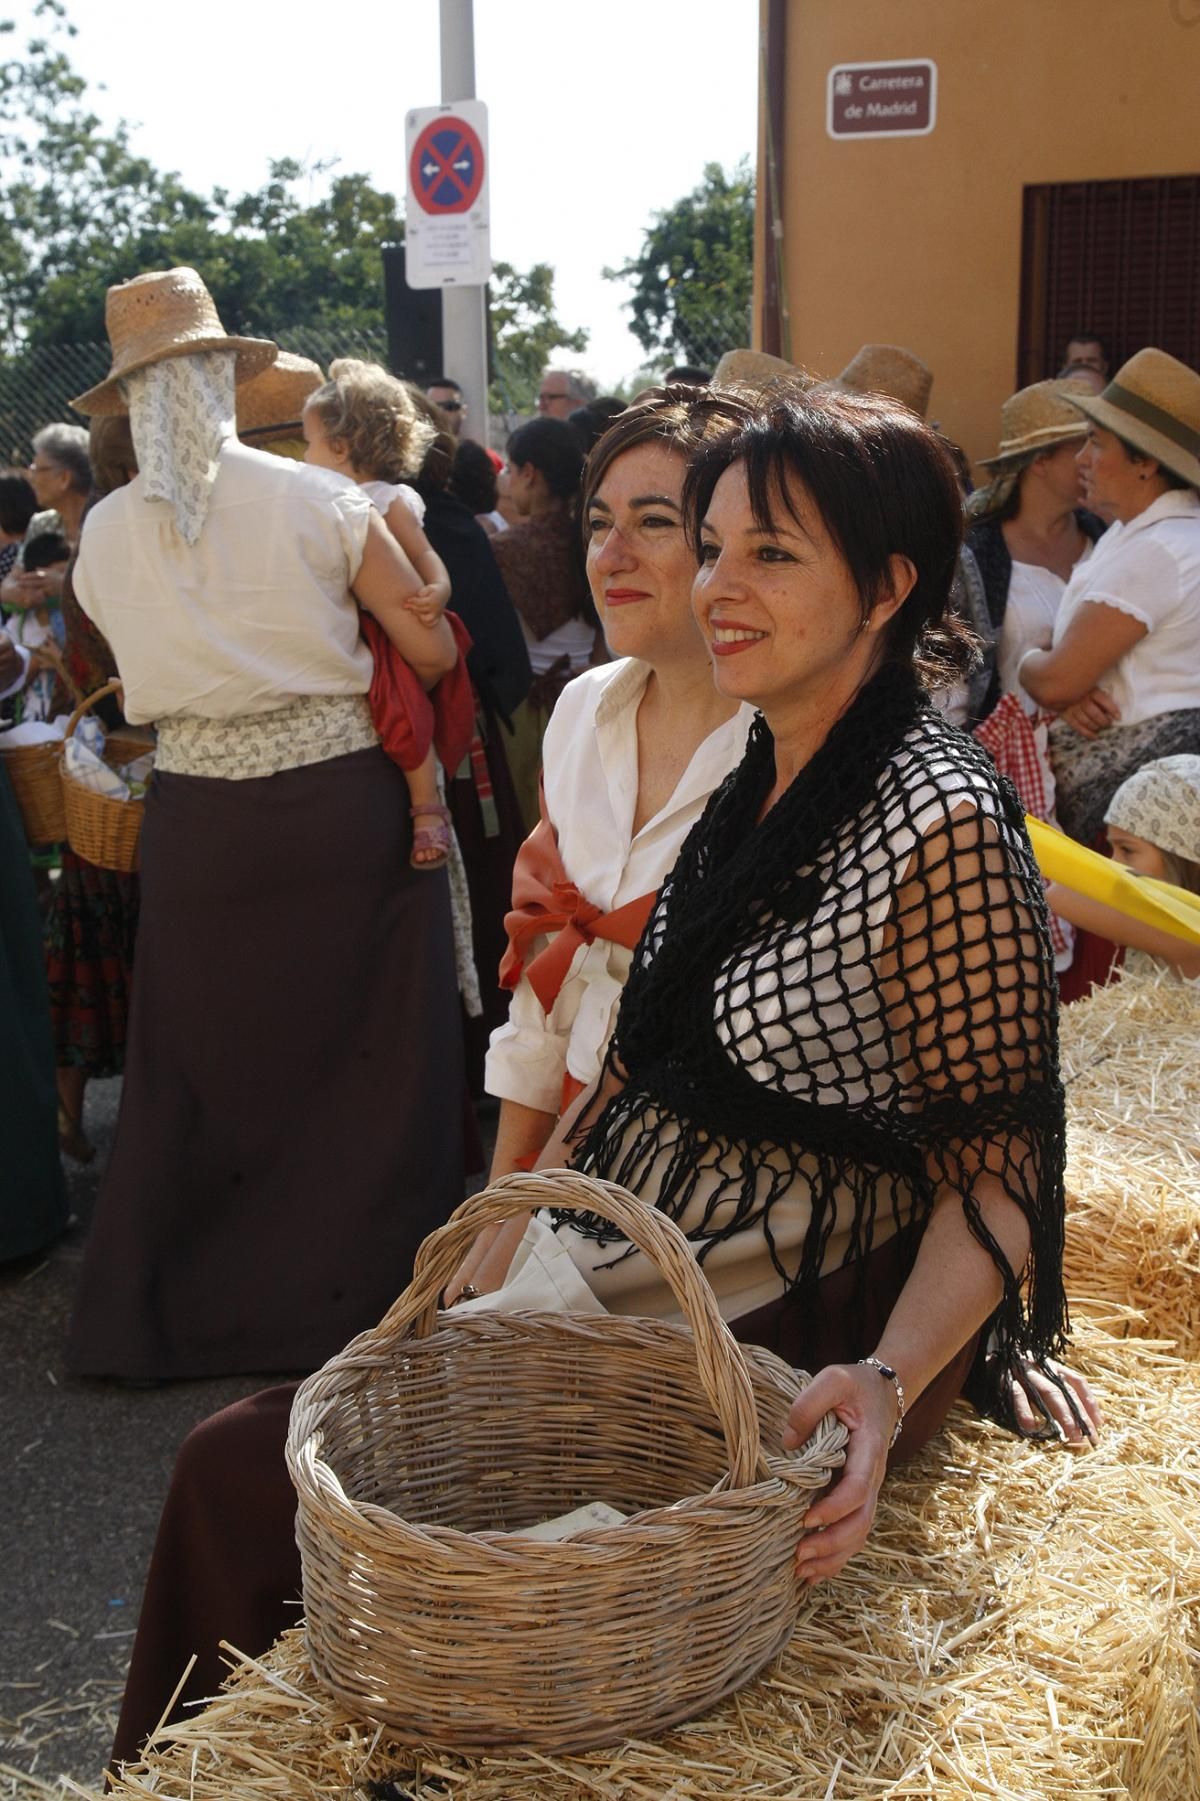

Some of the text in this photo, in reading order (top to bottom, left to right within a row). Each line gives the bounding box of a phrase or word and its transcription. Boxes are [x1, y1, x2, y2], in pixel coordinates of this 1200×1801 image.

[859, 75, 924, 91] Carretera
[844, 100, 918, 119] de Madrid
